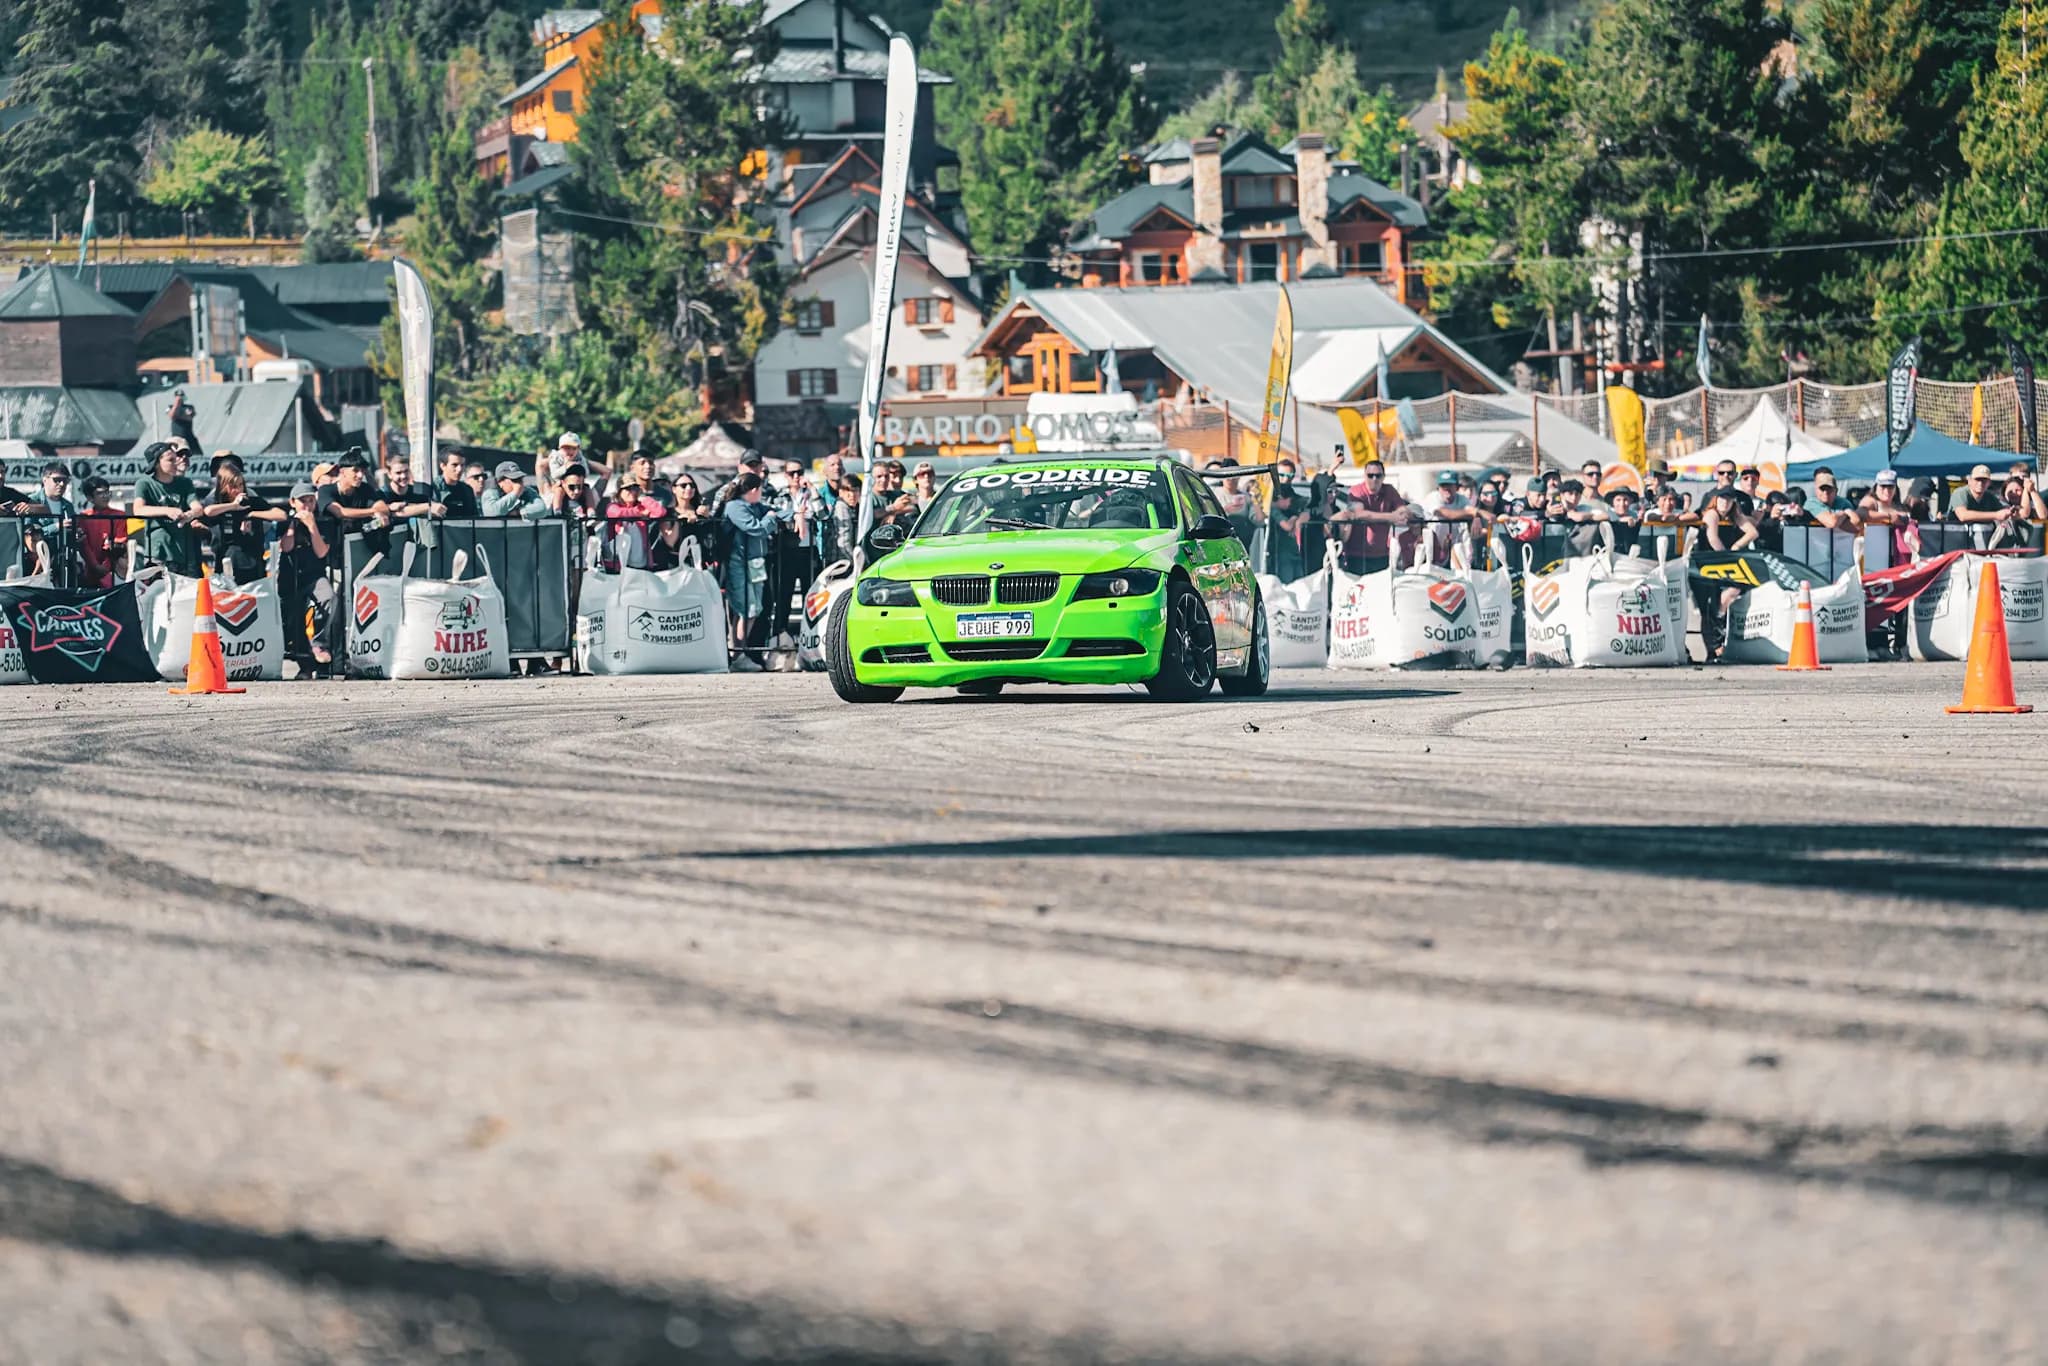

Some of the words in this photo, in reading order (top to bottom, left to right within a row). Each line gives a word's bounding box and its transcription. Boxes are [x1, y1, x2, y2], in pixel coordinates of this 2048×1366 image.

[885, 414, 1000, 447] BARTO
[1014, 411, 1138, 443] LOMOS
[657, 611, 702, 624] CANTERA
[660, 619, 702, 631] MORENO
[1616, 613, 1662, 636] NIRE
[959, 621, 1000, 636] JEQUE
[1006, 620, 1031, 634] 999
[1423, 623, 1474, 642] SÓLIDO
[434, 628, 488, 654] NIRE
